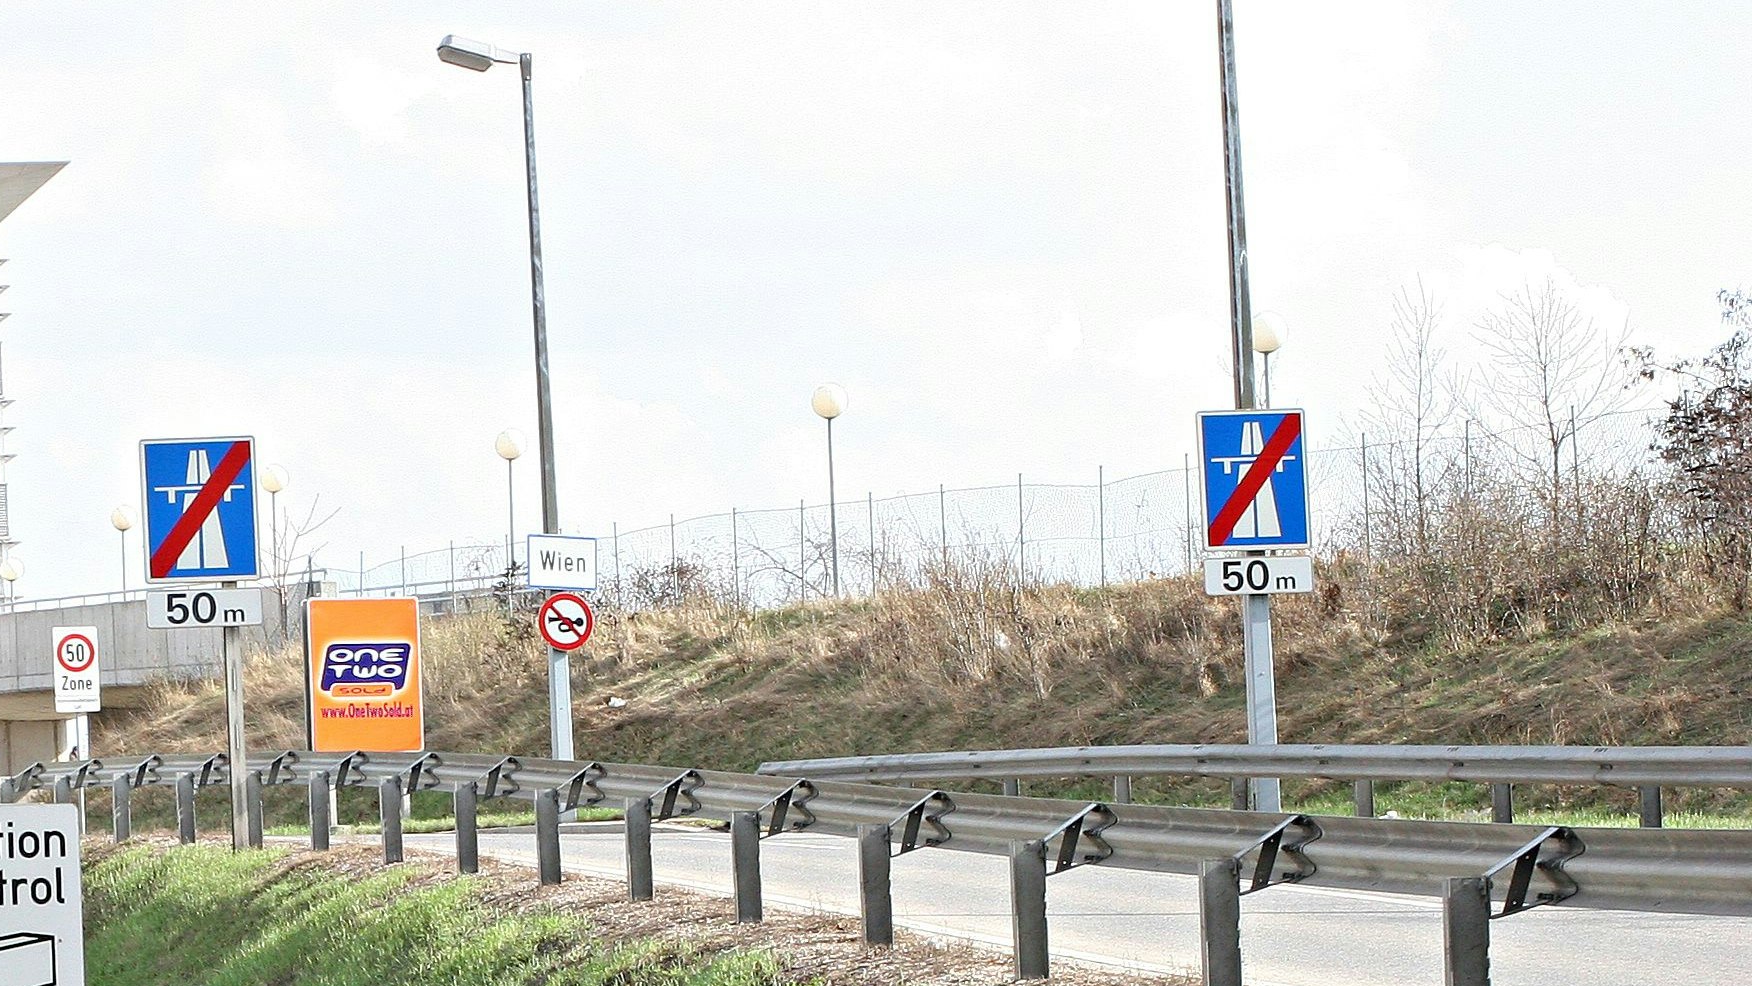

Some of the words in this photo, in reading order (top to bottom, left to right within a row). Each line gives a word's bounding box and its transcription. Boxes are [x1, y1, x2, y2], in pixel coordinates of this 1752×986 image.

[540, 550, 586, 572] Wien
[1223, 560, 1269, 591] 50
[1276, 576, 1296, 589] m
[167, 593, 217, 624] 50
[224, 608, 245, 622] m
[67, 644, 84, 662] 50
[328, 664, 403, 679] TWO
[62, 676, 93, 690] Zone
[320, 702, 414, 718] www.OneTwoSold.at
